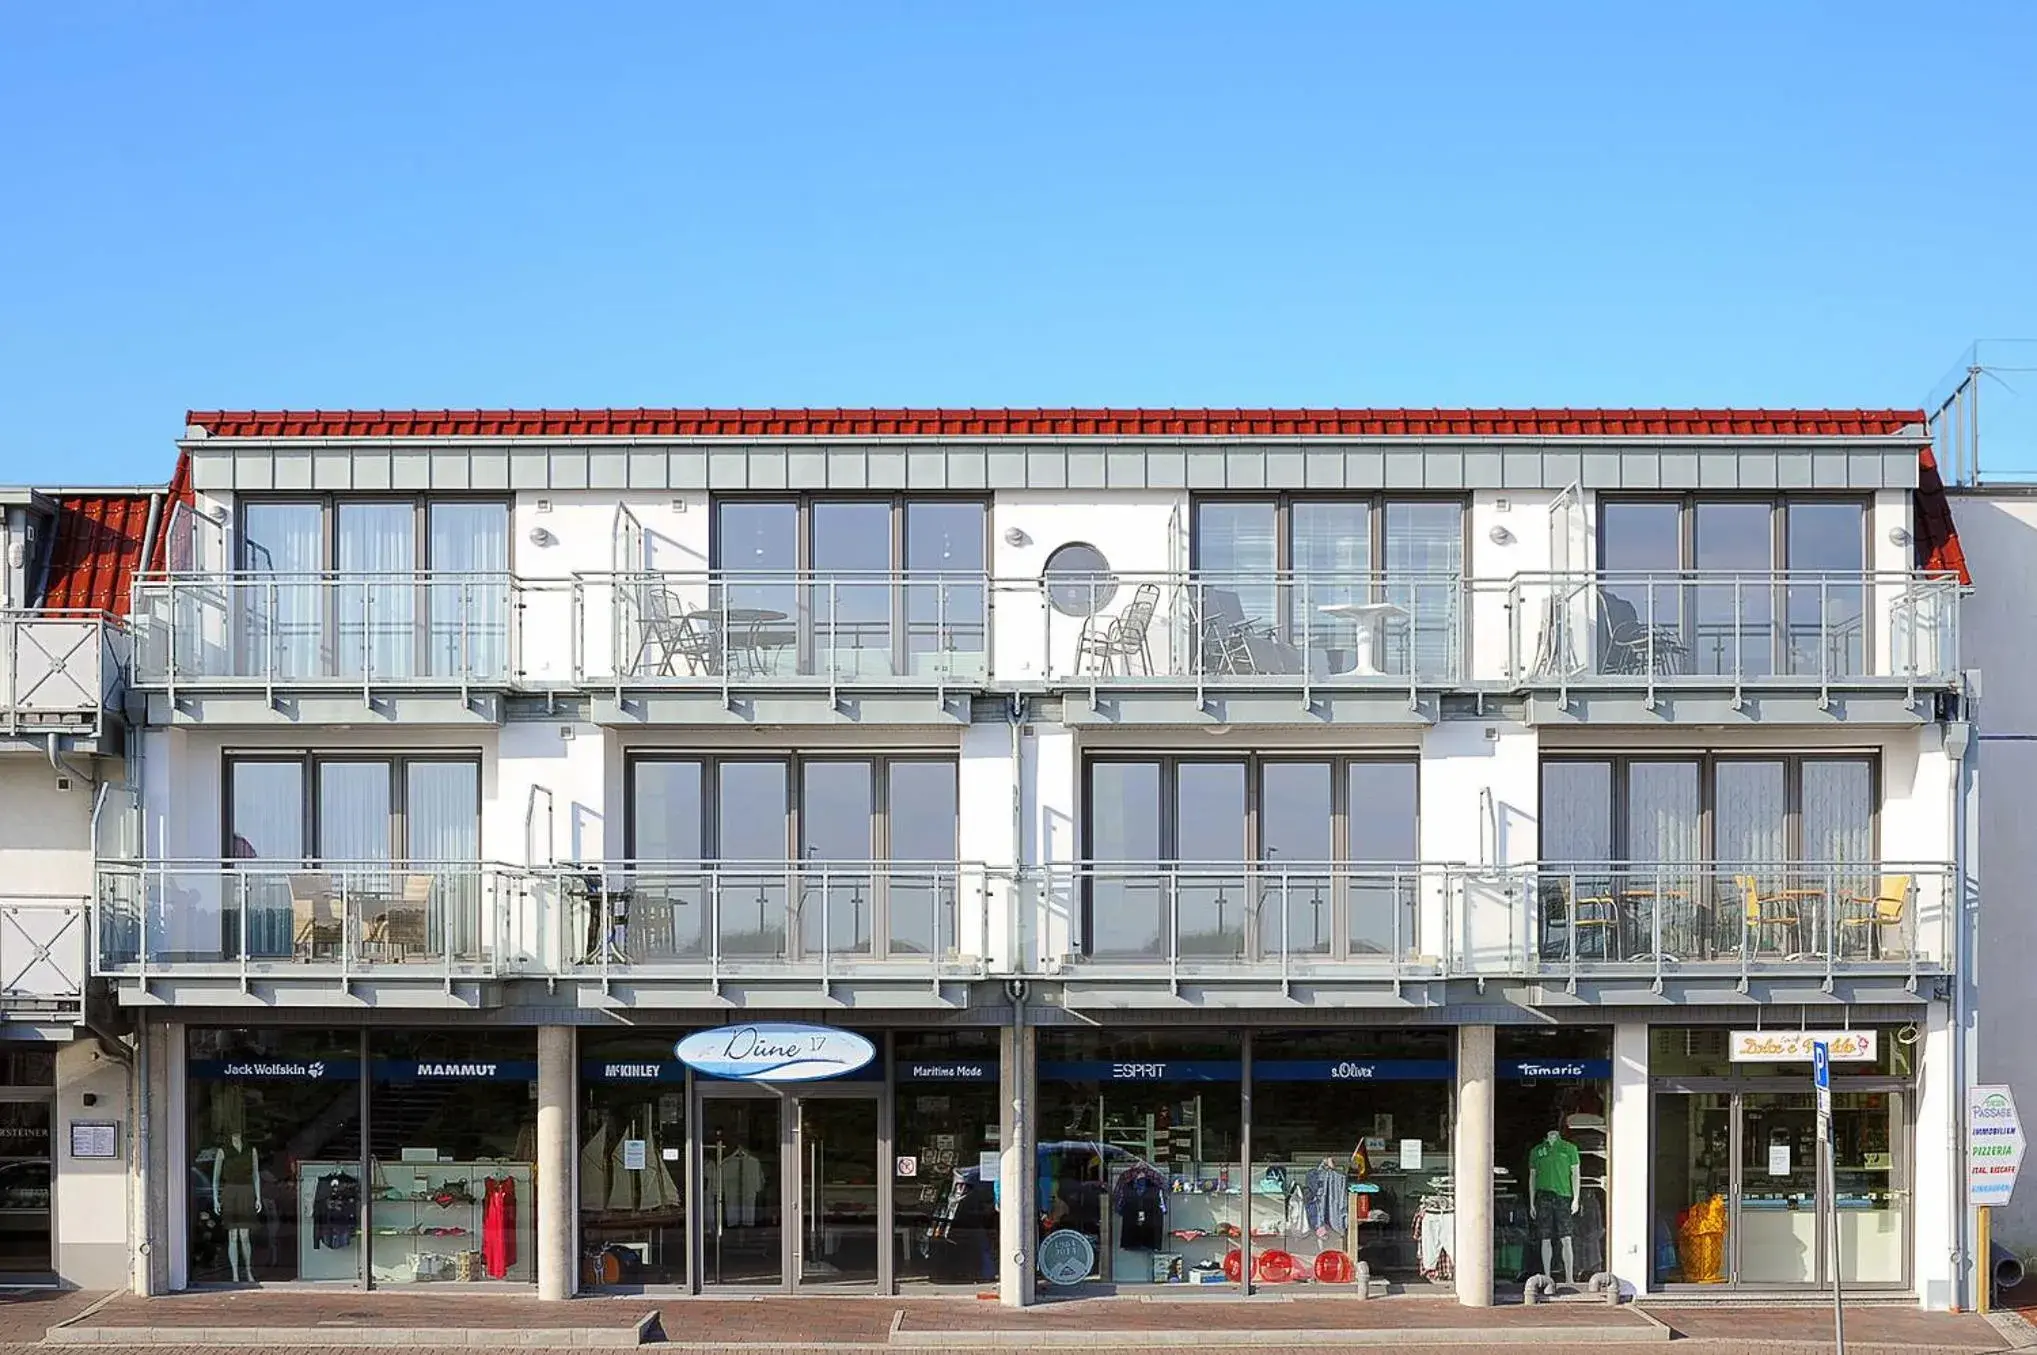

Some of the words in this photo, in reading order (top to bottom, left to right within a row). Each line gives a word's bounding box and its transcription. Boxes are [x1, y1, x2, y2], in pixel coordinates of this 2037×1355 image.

[723, 1027, 800, 1060] Düne
[811, 1036, 827, 1051] 17
[224, 1064, 253, 1075] Jack
[253, 1063, 306, 1075] Wolfskin
[417, 1063, 497, 1076] MAMMUT
[913, 1065, 955, 1077] Maritime
[956, 1065, 983, 1077] Mode
[1113, 1063, 1167, 1078] ESPRIT
[1517, 1063, 1582, 1076] Tamaris
[1816, 1046, 1825, 1083] P
[1972, 1105, 2013, 1119] PASSAGE
[1972, 1127, 2016, 1136] IMMOBILIEN
[1972, 1145, 2013, 1157] PIZZERIA
